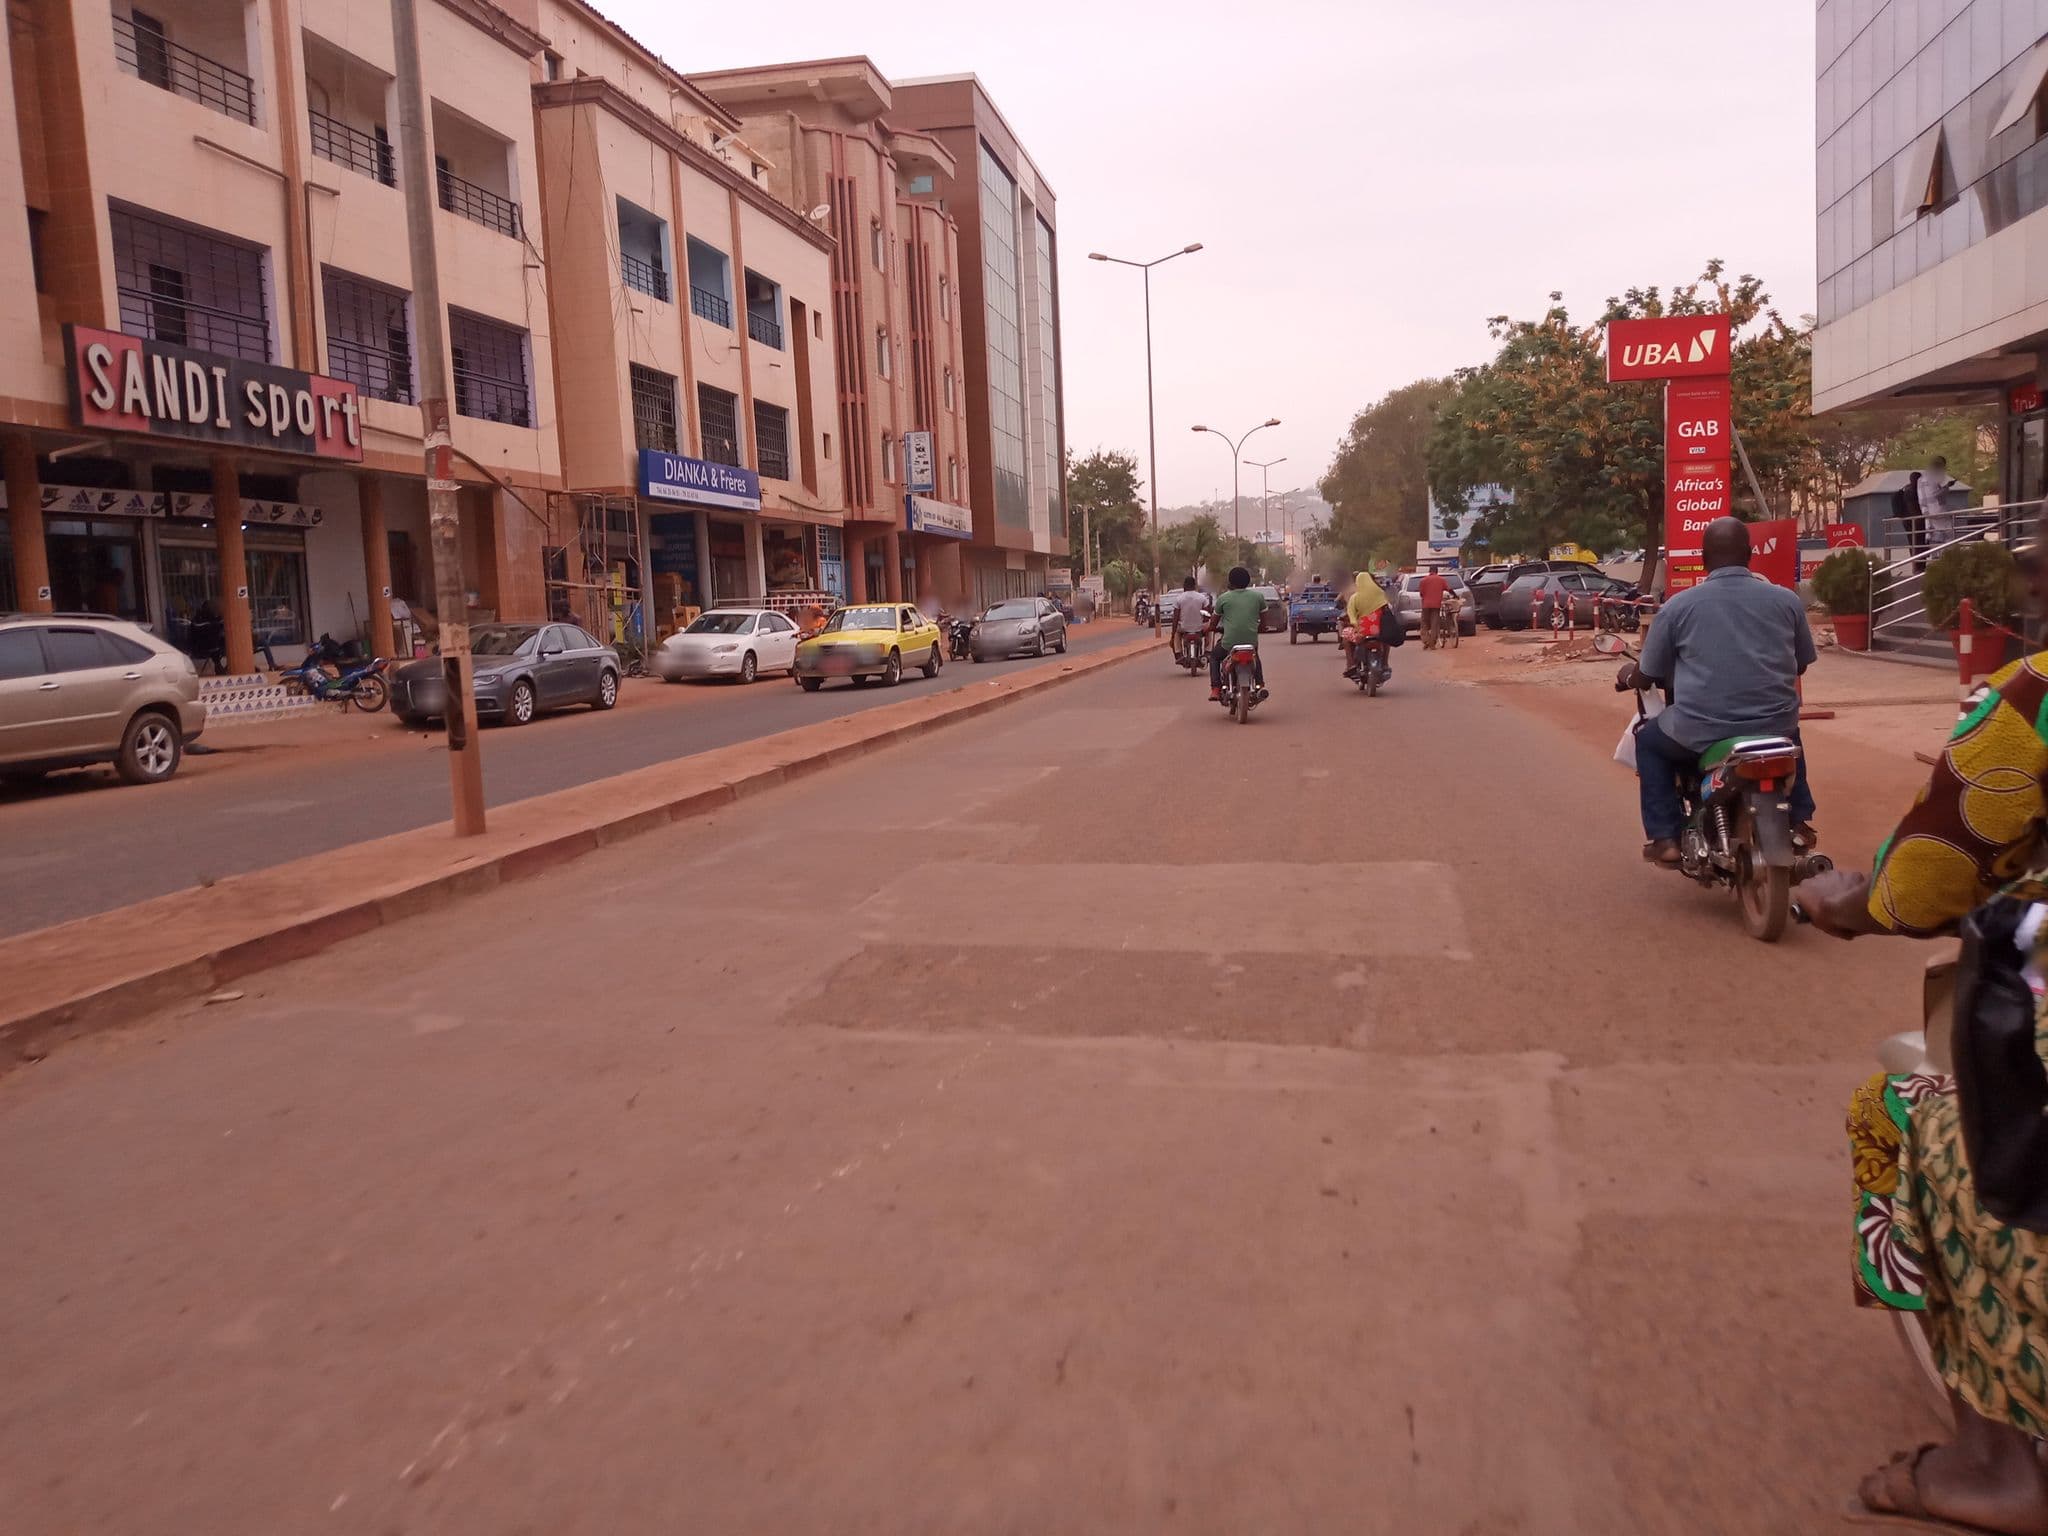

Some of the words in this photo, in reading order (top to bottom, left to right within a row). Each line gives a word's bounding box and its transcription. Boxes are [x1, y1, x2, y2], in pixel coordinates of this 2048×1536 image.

[1622, 342, 1682, 367] UBA
[87, 343, 231, 429] SANDI
[245, 380, 358, 446] sport
[1678, 420, 1719, 438] GAB
[664, 458, 709, 487] DIANKA
[711, 468, 719, 488] &
[720, 469, 747, 493] Frères
[1674, 477, 1723, 492] Africa's
[1676, 497, 1722, 512] Global
